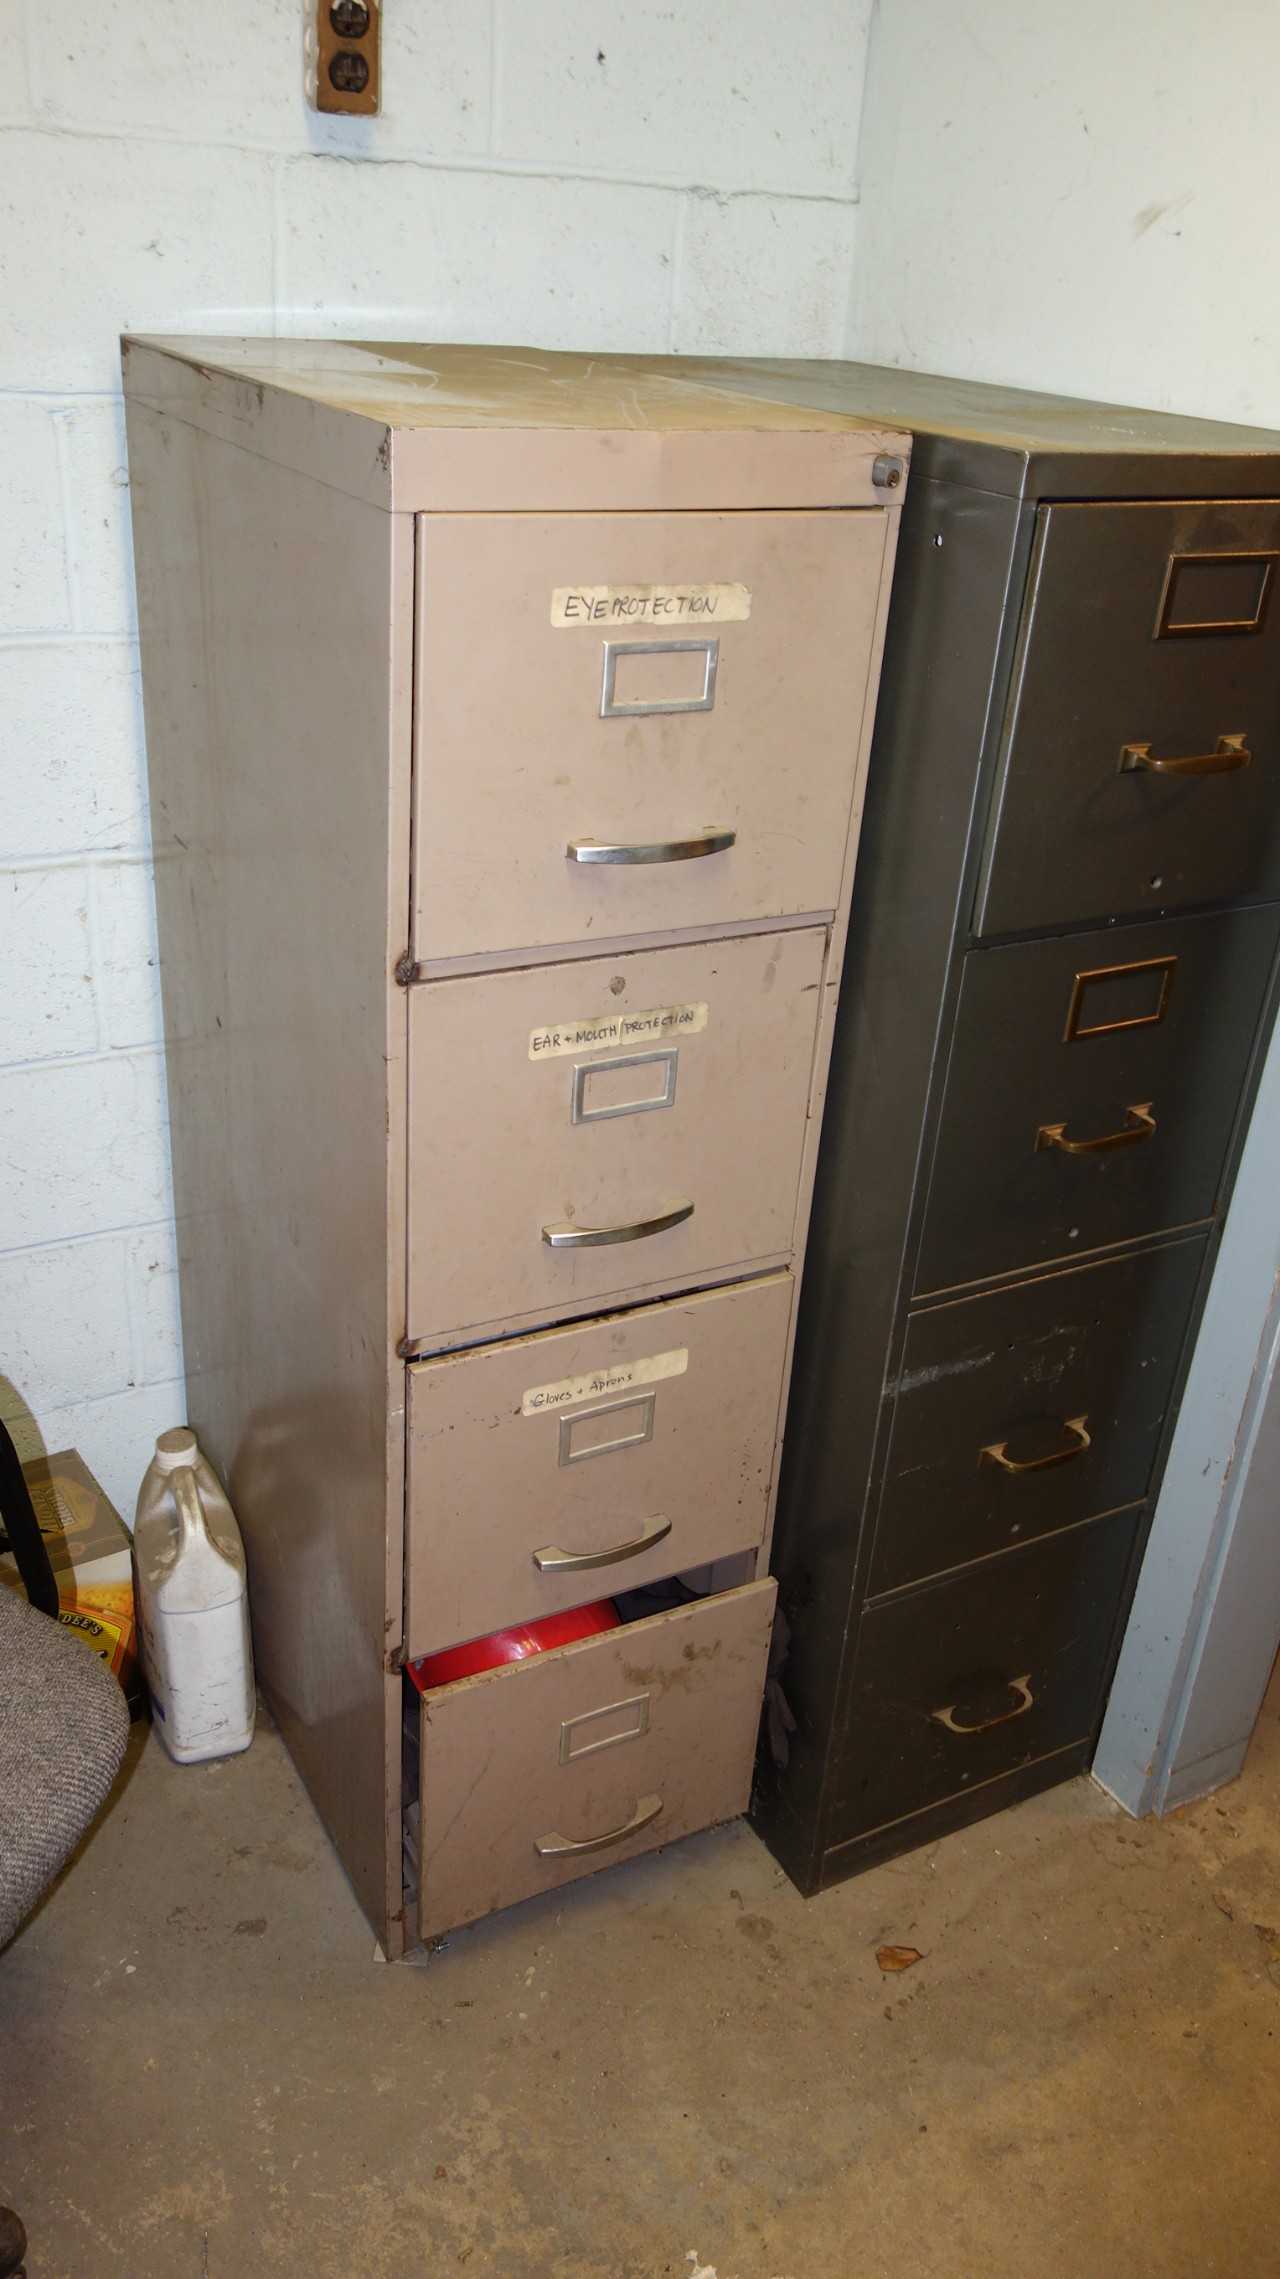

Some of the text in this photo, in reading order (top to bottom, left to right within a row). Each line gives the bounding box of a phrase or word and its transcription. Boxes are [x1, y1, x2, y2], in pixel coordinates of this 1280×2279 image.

[564, 595, 719, 621] EYE PROTECTION
[532, 1034, 561, 1051] EAR
[575, 1025, 617, 1043] MOUTH
[623, 1010, 695, 1034] PROTECTION
[533, 1392, 572, 1408] Gloves
[589, 1373, 633, 1393] Aprons
